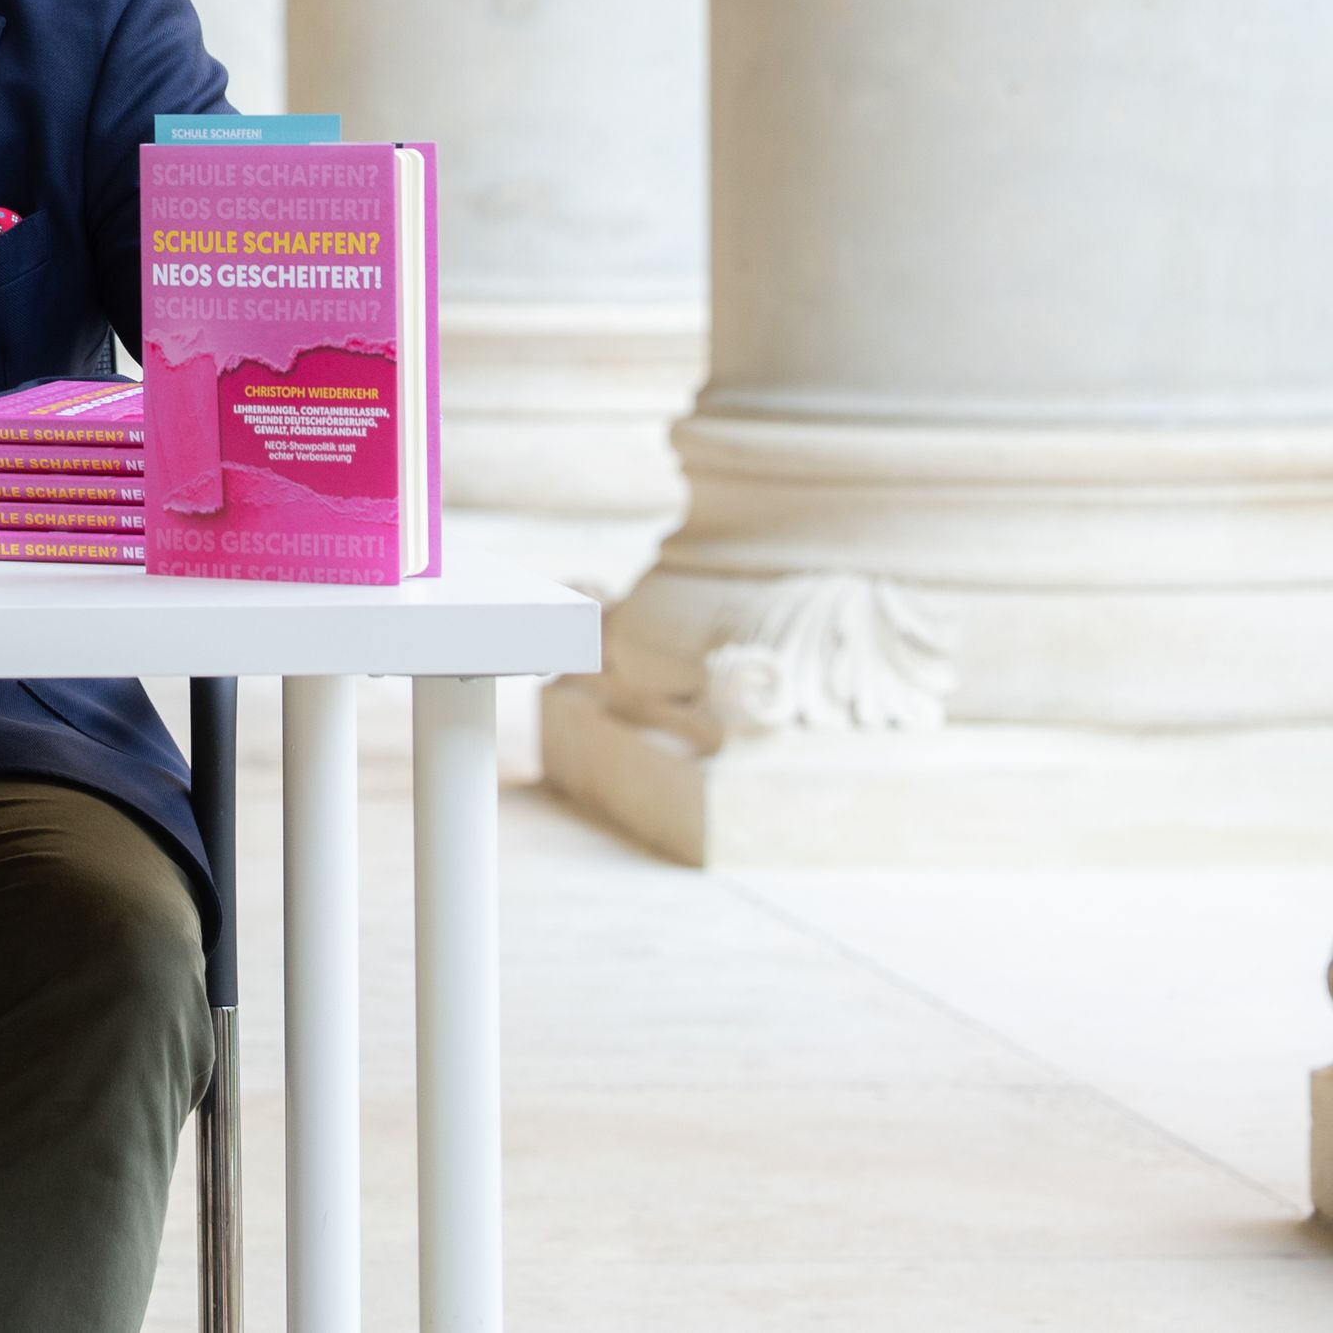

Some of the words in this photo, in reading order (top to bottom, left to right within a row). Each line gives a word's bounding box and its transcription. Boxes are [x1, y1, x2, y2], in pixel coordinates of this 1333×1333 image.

[172, 129, 207, 139] SCHULE
[152, 164, 236, 186] SCHULE
[243, 165, 378, 187] SCHAFFEN?
[152, 197, 211, 219] NEOS
[216, 198, 380, 220] GESCHEITERT!
[153, 230, 237, 253] SCHULE
[244, 231, 380, 255] SCHAFFEN?
[153, 264, 212, 287] NEOS
[217, 264, 381, 289] GESCHEITERT!
[154, 297, 238, 320] SCHULE
[244, 298, 381, 322] SCHAFFEN?
[245, 386, 305, 398] CHRISTOPH
[308, 387, 379, 399] WIEDERKEHR
[233, 405, 299, 415] LEHRERMANGEL,
[301, 406, 389, 418] CONTAINERKLASSEN,
[244, 416, 283, 425] FEHLENDE
[285, 416, 377, 428] DEUTSCHFÖRDERUNG,
[34, 429, 124, 441] SCHAFFEN?
[254, 426, 289, 435] GEWALT,
[290, 425, 366, 436] FÖRDERSKANDALE
[265, 441, 336, 452] NEOS-Showpolitik
[338, 443, 356, 452] statt
[269, 452, 294, 460] echter
[296, 452, 351, 463] Verbesserung
[29, 459, 121, 471] SCHAFFEN?
[126, 460, 144, 471] NE
[26, 487, 116, 499] SCHAFFEN?
[121, 489, 144, 500] NE
[25, 514, 116, 526] SCHAFFEN?
[121, 517, 145, 527] NE
[156, 528, 215, 551] NEOS
[221, 530, 385, 558] GESCHEITERT!
[25, 544, 118, 558] SCHAFFEN?
[123, 547, 144, 558] NE
